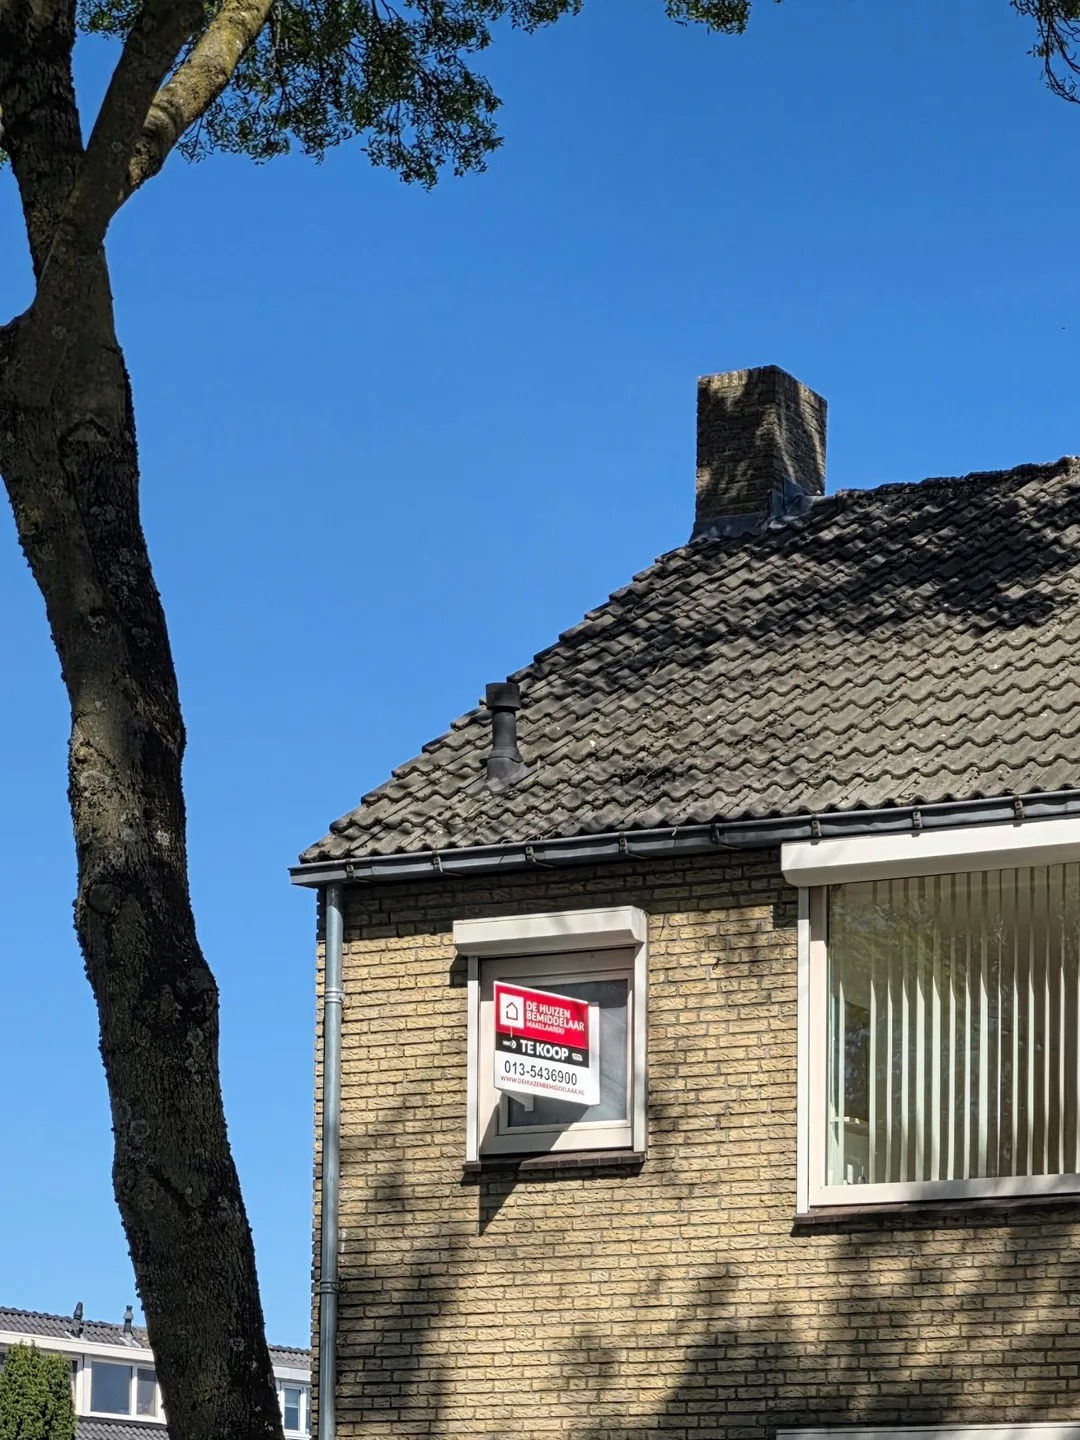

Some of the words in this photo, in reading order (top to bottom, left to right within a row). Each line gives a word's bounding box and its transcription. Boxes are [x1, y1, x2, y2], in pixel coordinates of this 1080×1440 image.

[526, 1001, 537, 1012] DE
[540, 1004, 571, 1019] HUIZEN
[526, 1011, 585, 1031] BEMIDDELAAR
[520, 1039, 534, 1054] TE
[536, 1043, 569, 1060] KOOP
[504, 1060, 577, 1085] 013-5436900
